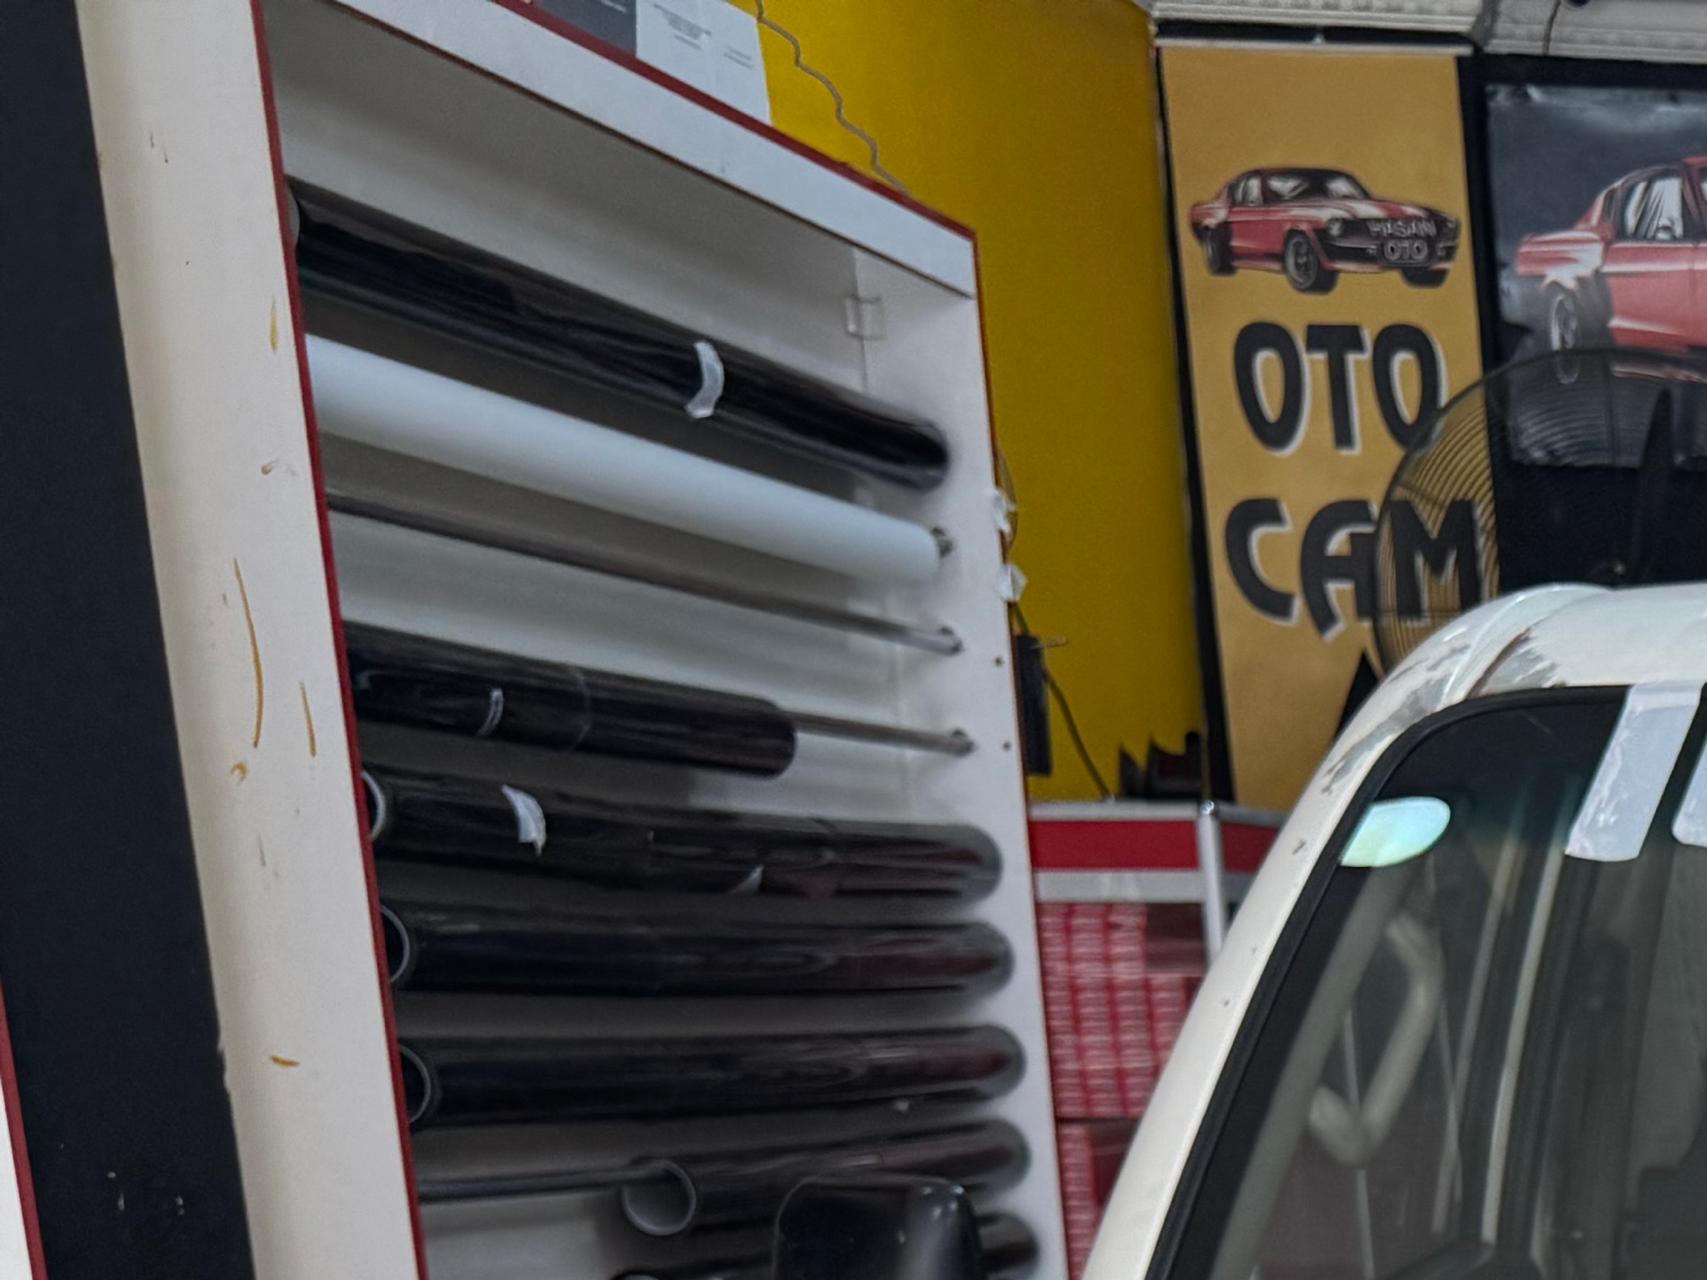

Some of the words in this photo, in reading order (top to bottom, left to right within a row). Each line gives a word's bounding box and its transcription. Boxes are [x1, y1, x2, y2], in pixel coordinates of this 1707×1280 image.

[1383, 238, 1429, 261] OTO
[1234, 321, 1448, 457] OTO
[1224, 497, 1485, 641] CAM
